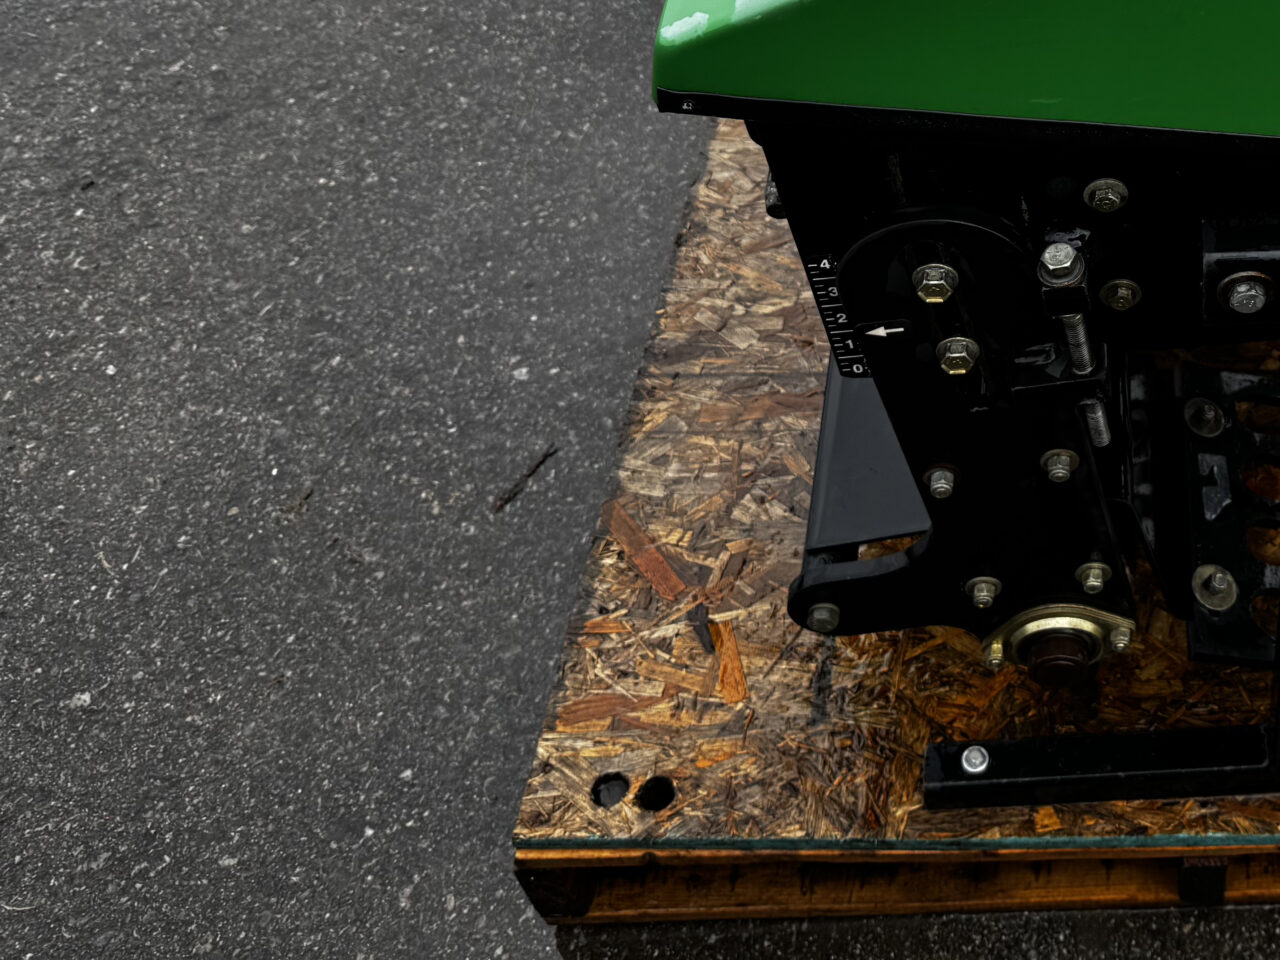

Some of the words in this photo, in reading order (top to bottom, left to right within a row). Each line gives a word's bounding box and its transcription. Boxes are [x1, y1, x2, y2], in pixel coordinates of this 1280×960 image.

[820, 259, 830, 269] 4
[828, 286, 839, 297] 3
[836, 313, 848, 323] 2
[845, 339, 854, 349] 1
[852, 363, 864, 373] 0
